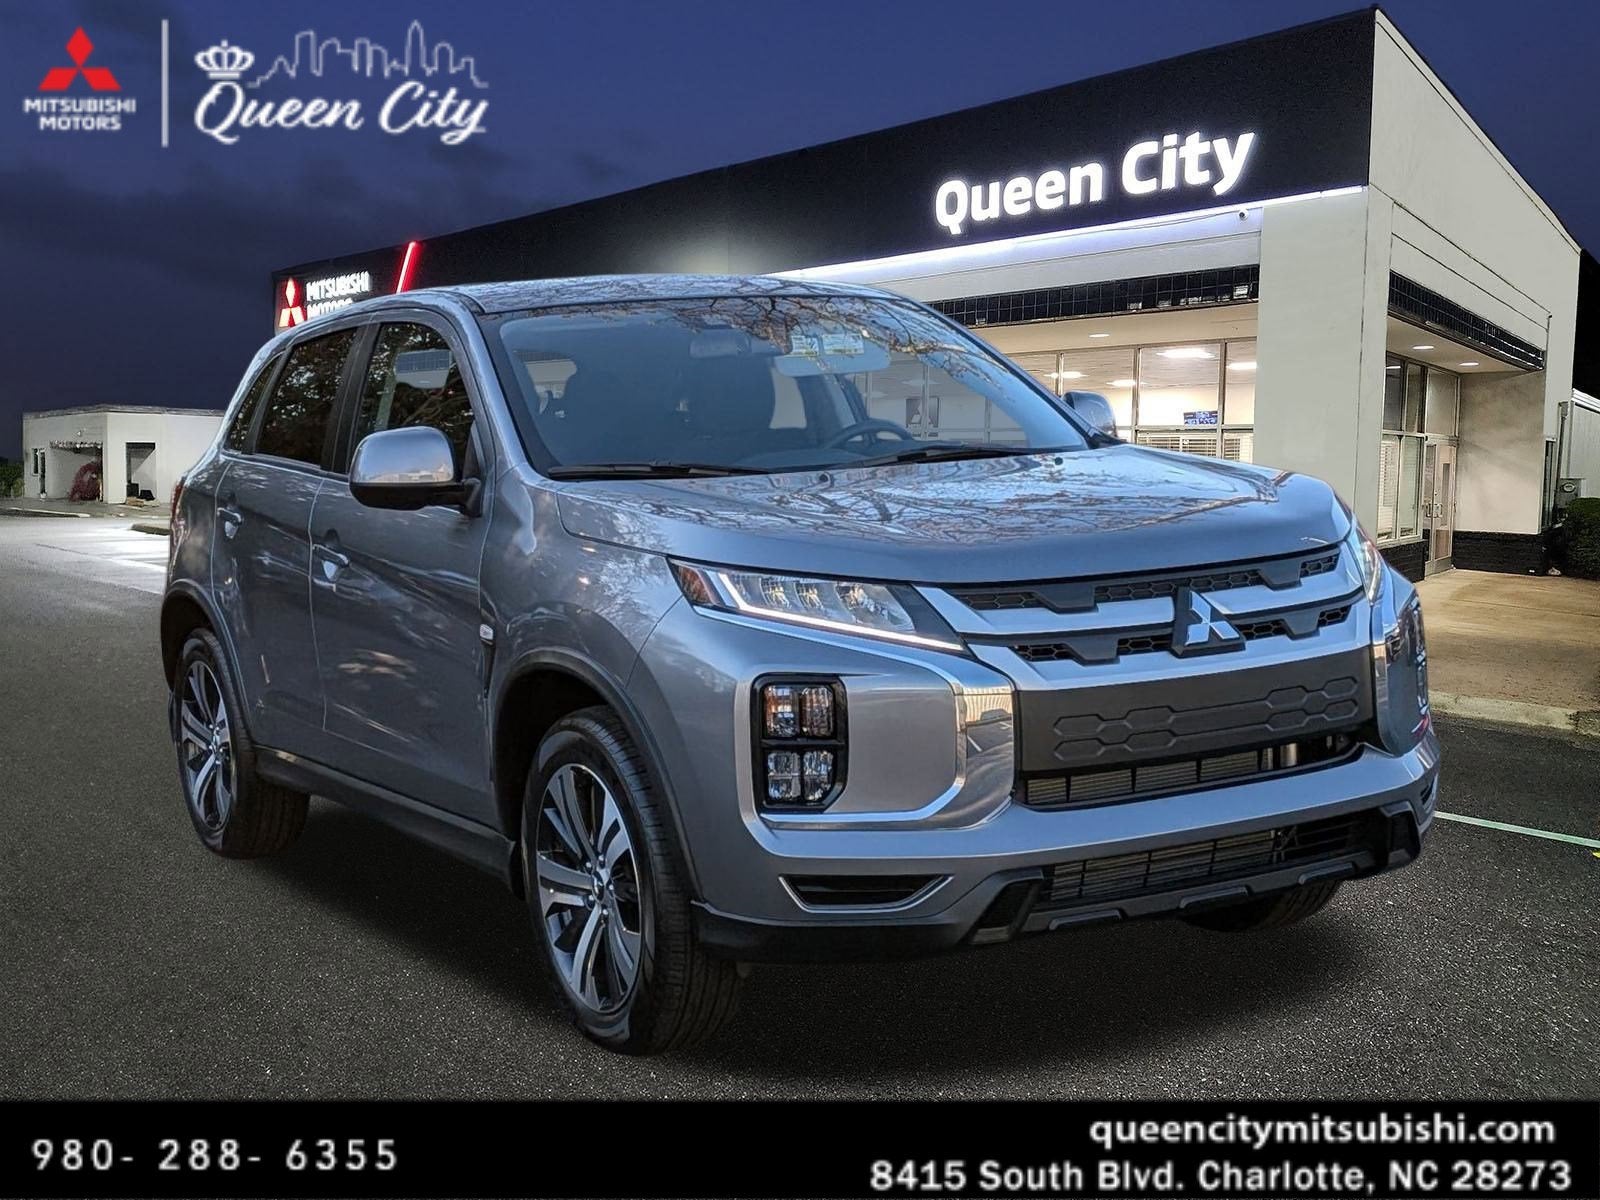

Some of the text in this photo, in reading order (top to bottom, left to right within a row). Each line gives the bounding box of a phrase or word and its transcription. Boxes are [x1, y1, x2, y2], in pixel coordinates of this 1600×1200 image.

[935, 131, 1255, 235] Queen City
[306, 270, 370, 301] MITSUBISHI
